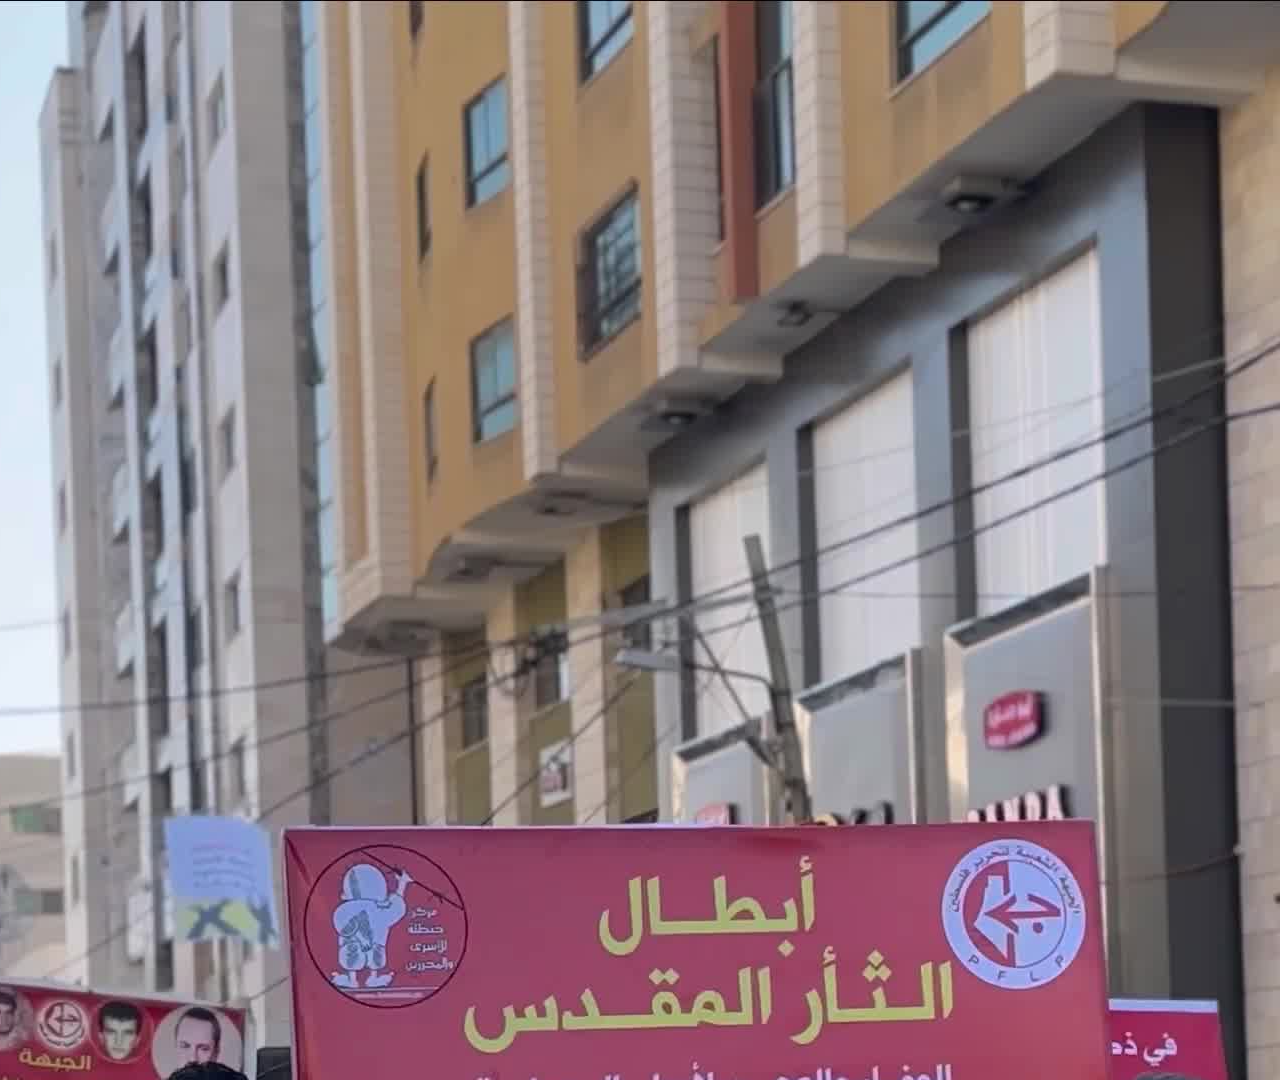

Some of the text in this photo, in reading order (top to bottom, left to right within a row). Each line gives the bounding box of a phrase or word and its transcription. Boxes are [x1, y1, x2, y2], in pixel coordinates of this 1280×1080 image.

[599, 855, 815, 956] أبطال
[464, 946, 955, 1053] الثأر المقدس
[19, 1048, 91, 1071] الجبهة
[1143, 1032, 1178, 1067] في
